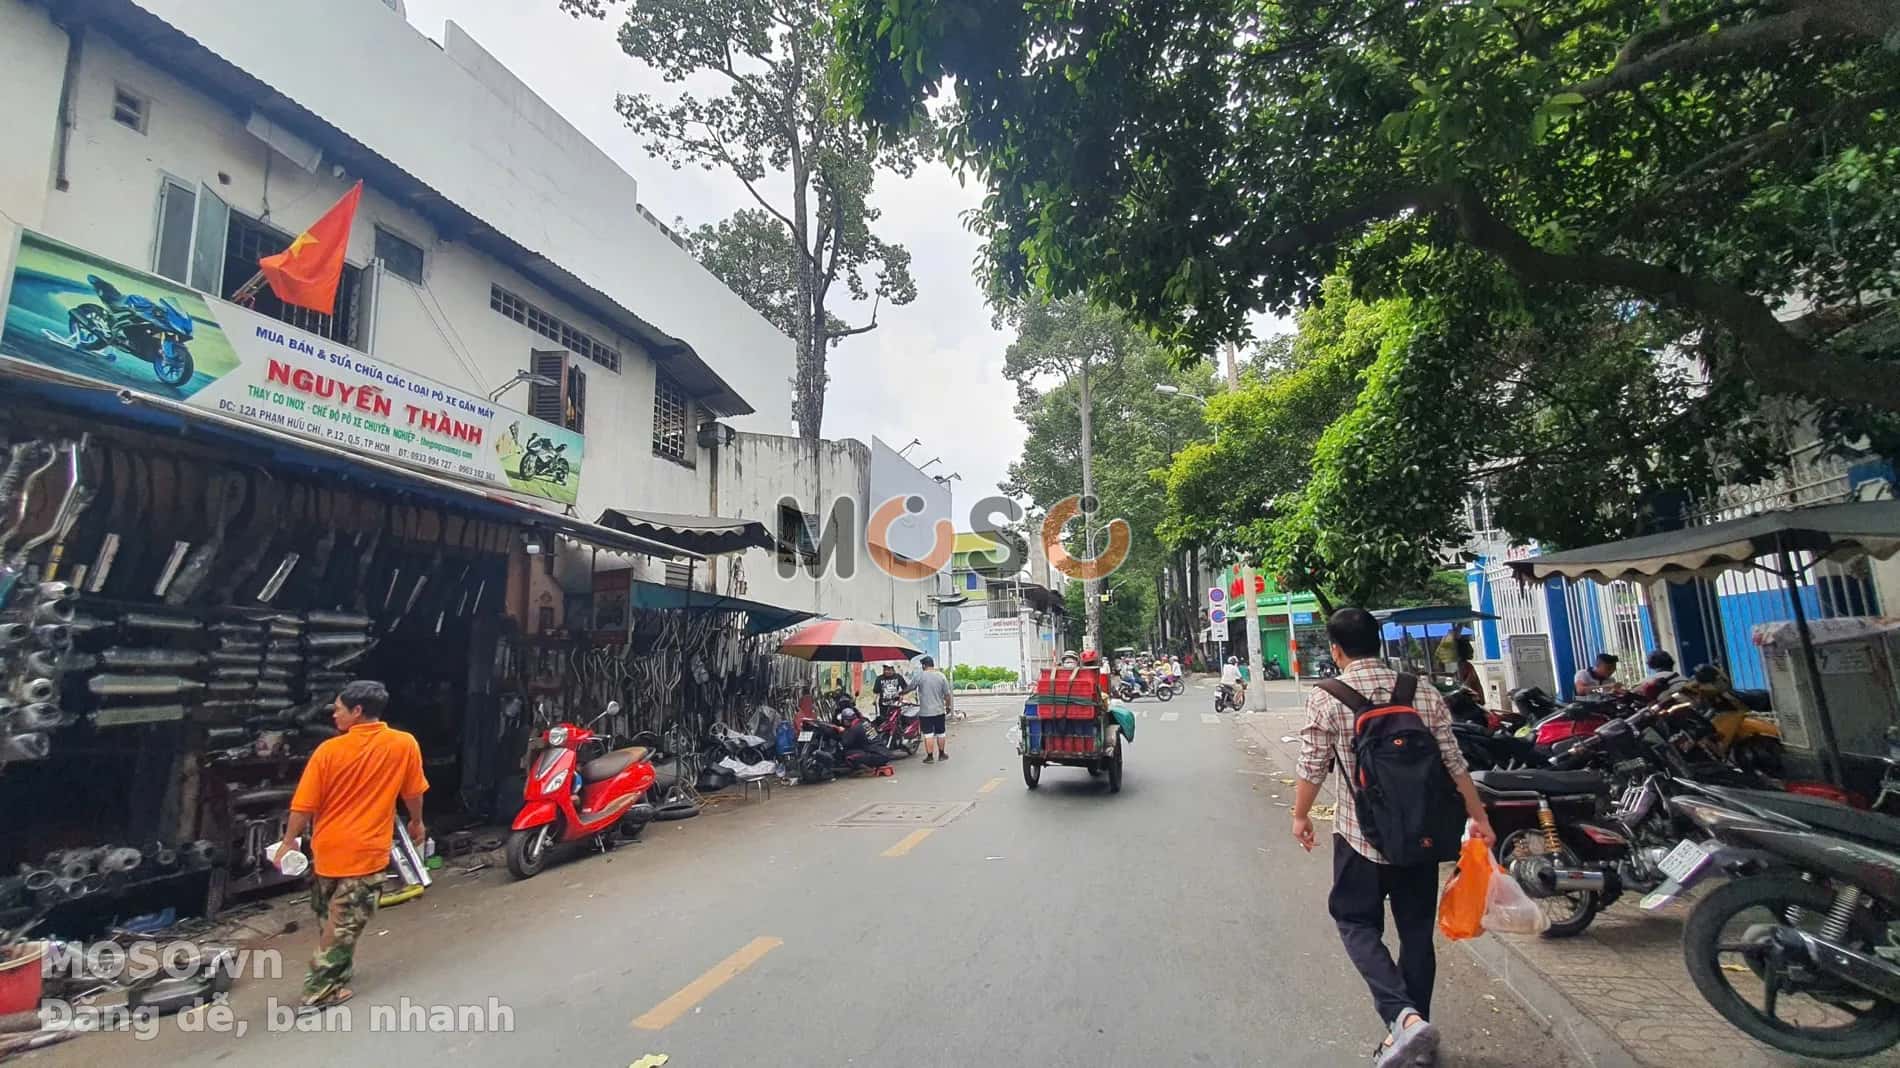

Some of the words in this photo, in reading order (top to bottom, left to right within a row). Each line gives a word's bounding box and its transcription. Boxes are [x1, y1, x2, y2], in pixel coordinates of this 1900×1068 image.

[256, 326, 285, 346] MUA
[288, 338, 314, 356] BÁN
[317, 349, 326, 360] &
[329, 352, 352, 370] SỬA
[354, 363, 383, 381] CHỮA
[385, 373, 406, 388] CÁC
[446, 395, 457, 407] XE
[477, 407, 496, 420] MÁY
[267, 359, 393, 418] NGUYỄN
[405, 403, 484, 445] THÀNH
[239, 404, 257, 418] 12A
[259, 409, 285, 425] PHẠM
[247, 384, 271, 401] THAY
[272, 393, 284, 405] CO
[285, 397, 306, 412] INOX
[353, 416, 362, 428] XE
